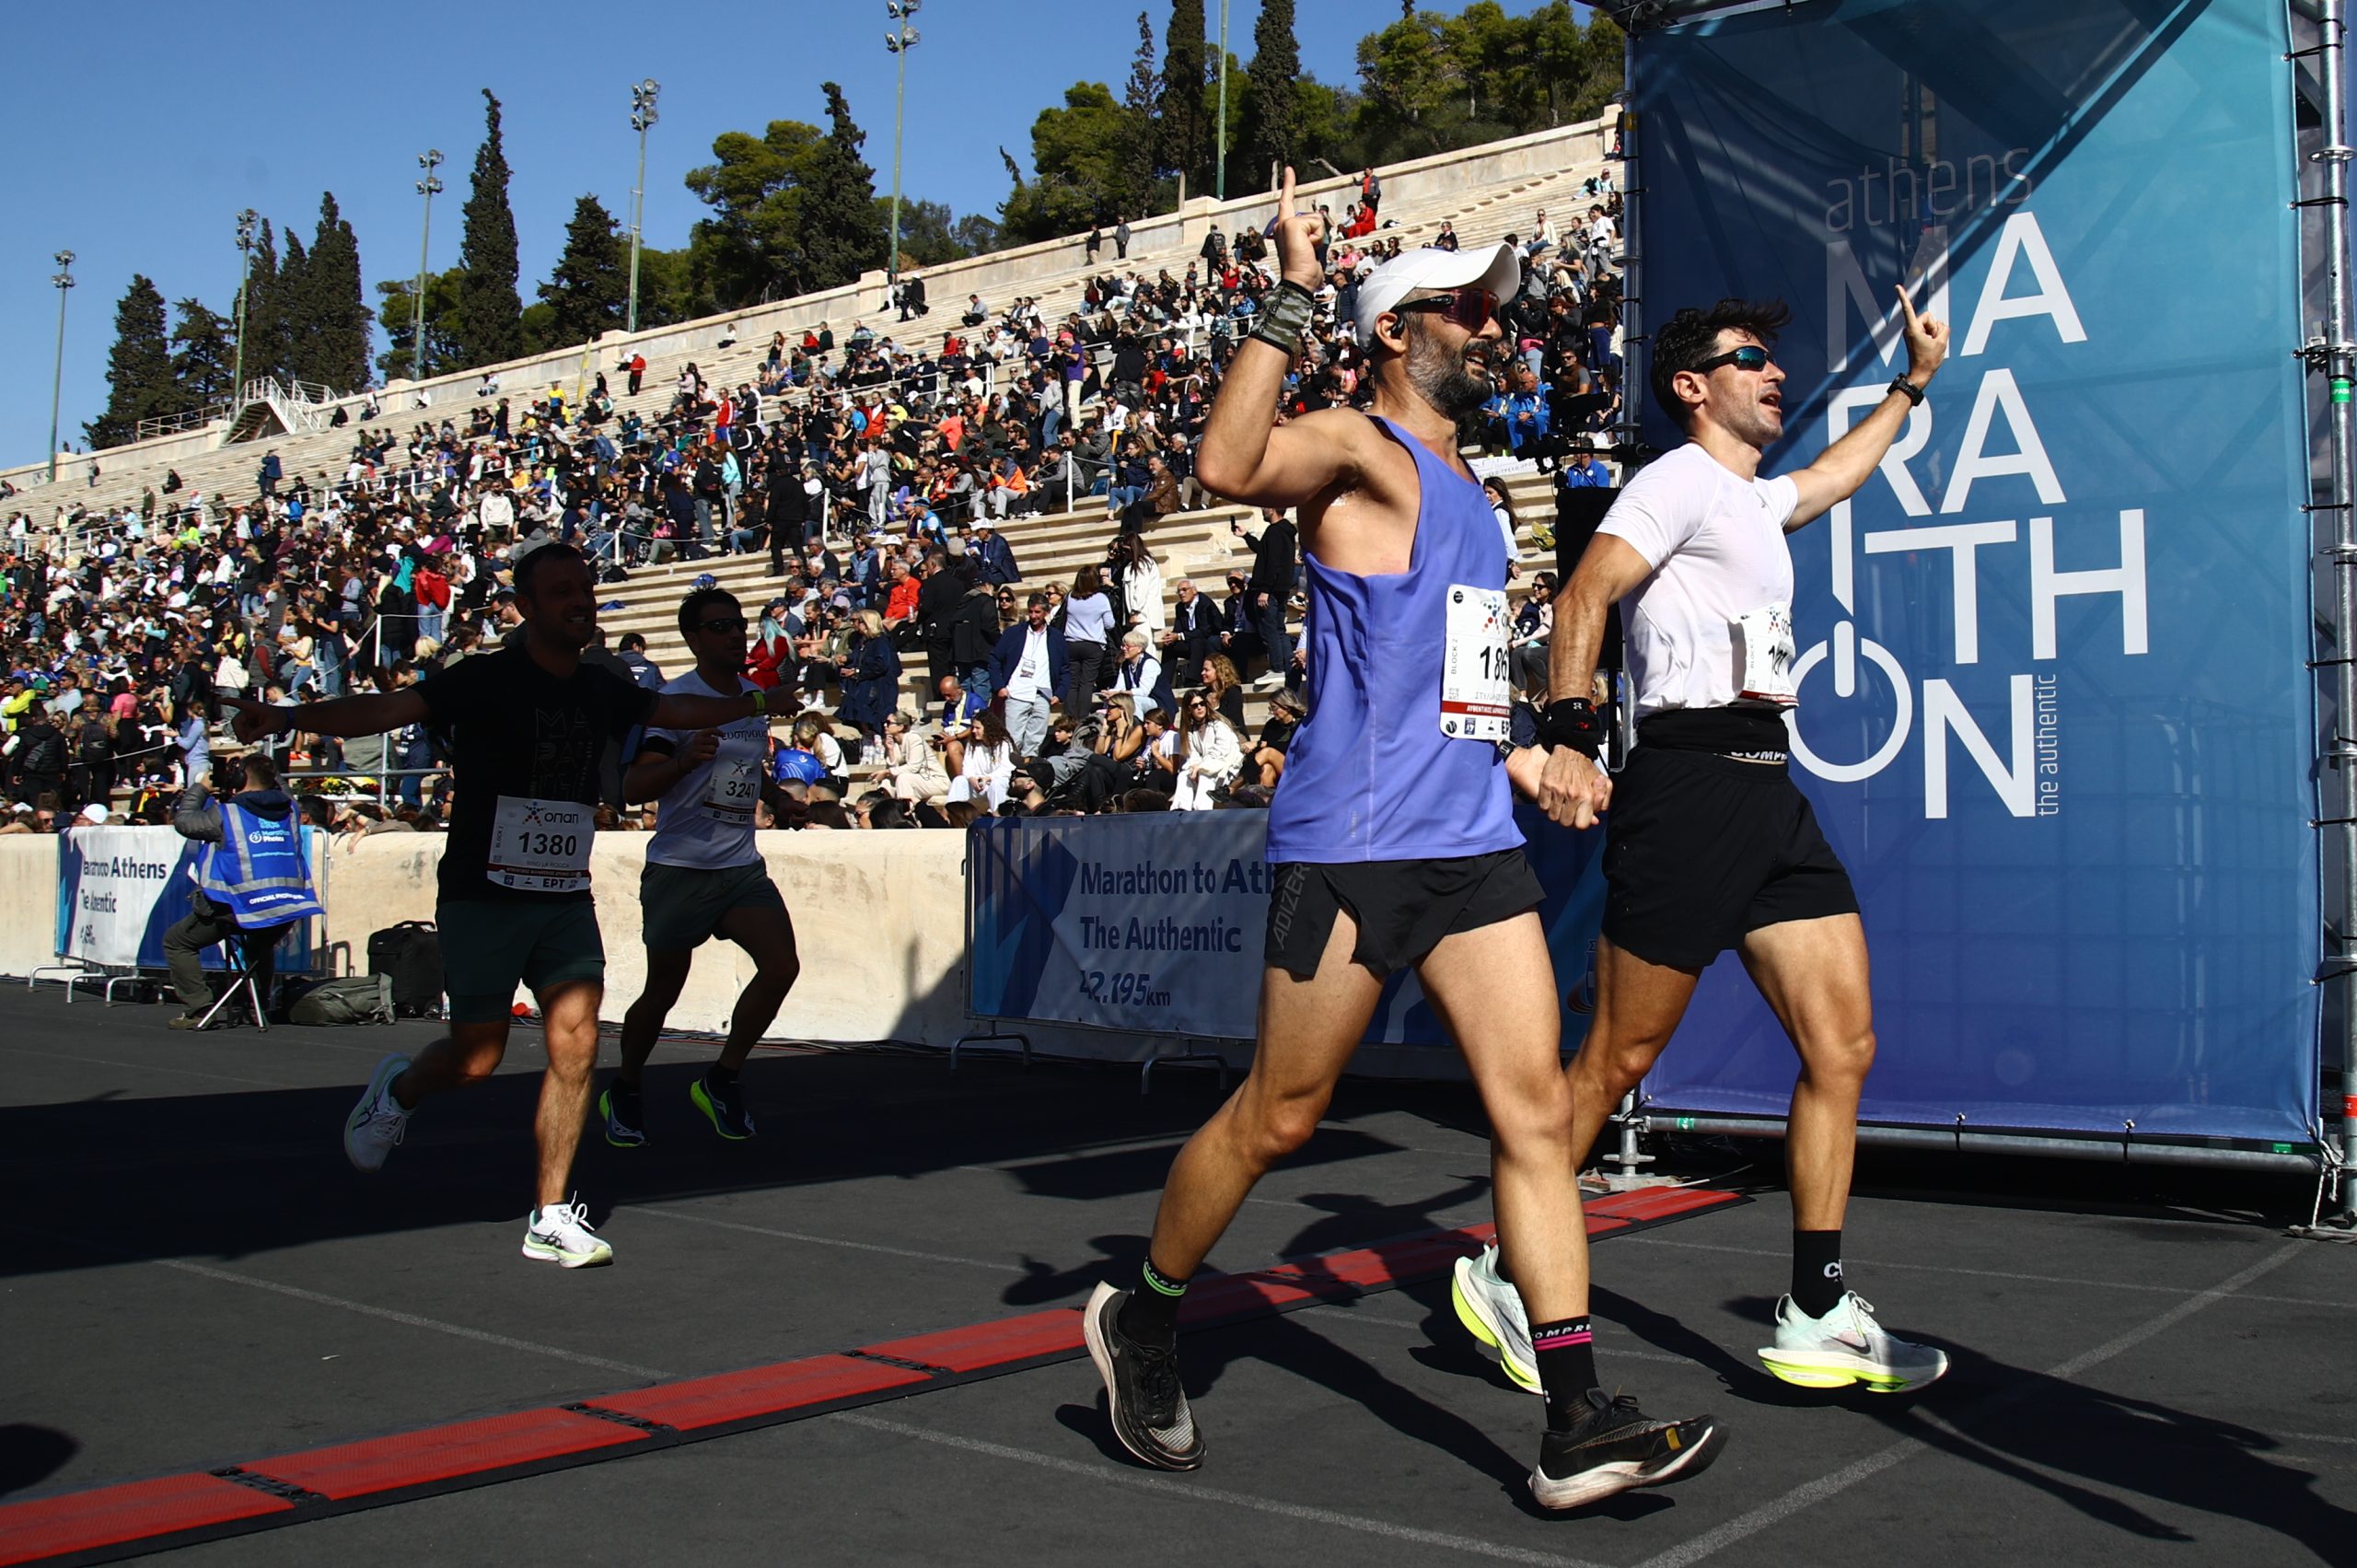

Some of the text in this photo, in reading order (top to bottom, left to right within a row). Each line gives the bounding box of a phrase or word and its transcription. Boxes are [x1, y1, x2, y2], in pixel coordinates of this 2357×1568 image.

[1825, 147, 2033, 232] athens
[2035, 674, 2059, 817] the authentic
[726, 781, 755, 798] 3247
[518, 832, 576, 856] 1380
[110, 855, 167, 879] Athens
[1080, 861, 1187, 895] Marathon
[1193, 861, 1215, 894] to
[1080, 916, 1242, 953] The Authentic
